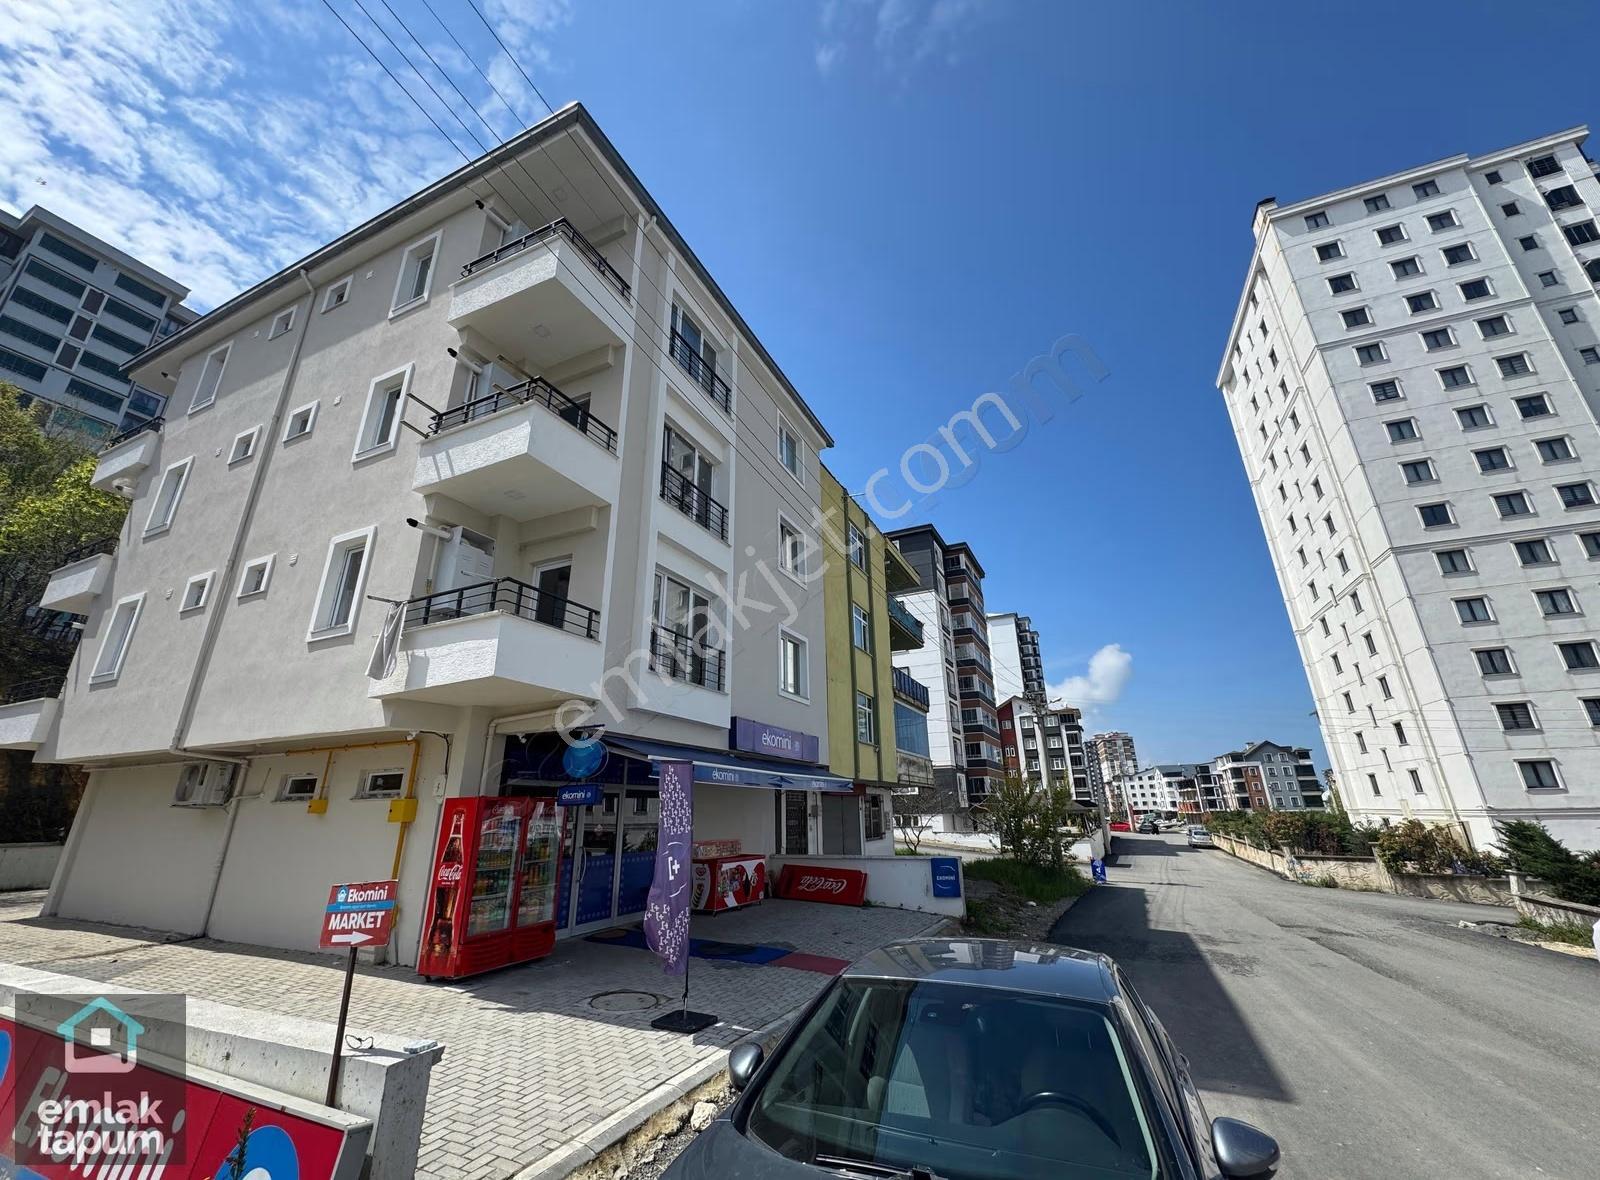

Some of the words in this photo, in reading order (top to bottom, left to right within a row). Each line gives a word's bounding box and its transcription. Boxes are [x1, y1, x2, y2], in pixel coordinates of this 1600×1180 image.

[762, 729, 792, 750] ekomini
[712, 768, 735, 781] ekomini
[347, 885, 389, 902] Ekomini
[328, 911, 386, 930] MARKET
